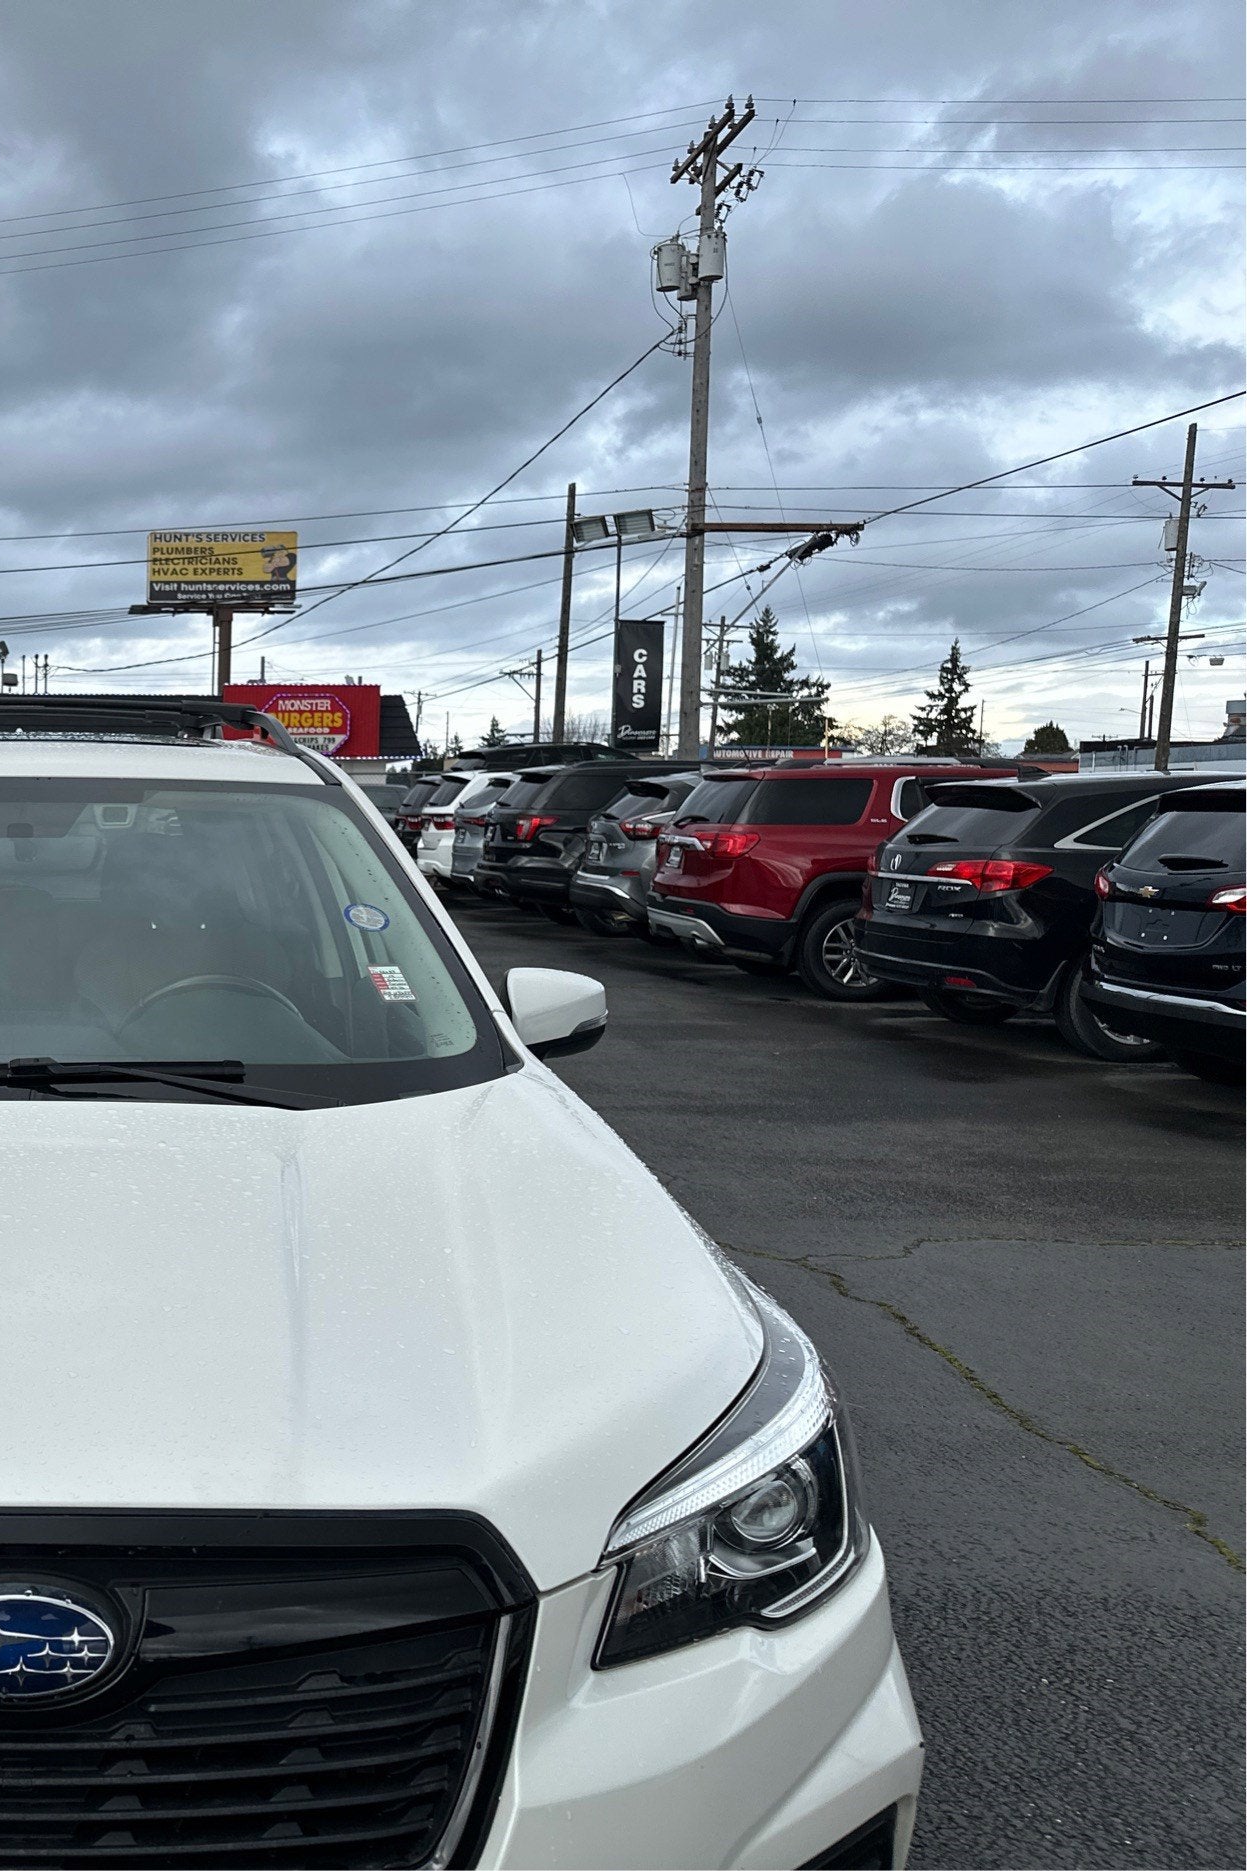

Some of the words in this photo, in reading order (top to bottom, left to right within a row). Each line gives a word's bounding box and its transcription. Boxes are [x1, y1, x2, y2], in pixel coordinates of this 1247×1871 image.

[153, 533, 203, 543] HUNT'S
[205, 533, 266, 542] SERVICES
[152, 547, 215, 556] PLUMBERS
[152, 557, 238, 566] ELECTRICIANS
[152, 567, 189, 576] HVAC
[193, 567, 244, 576] EXPERTS
[152, 582, 178, 591] Visit
[632, 648, 648, 709] CARS
[278, 699, 331, 710] MONSTER
